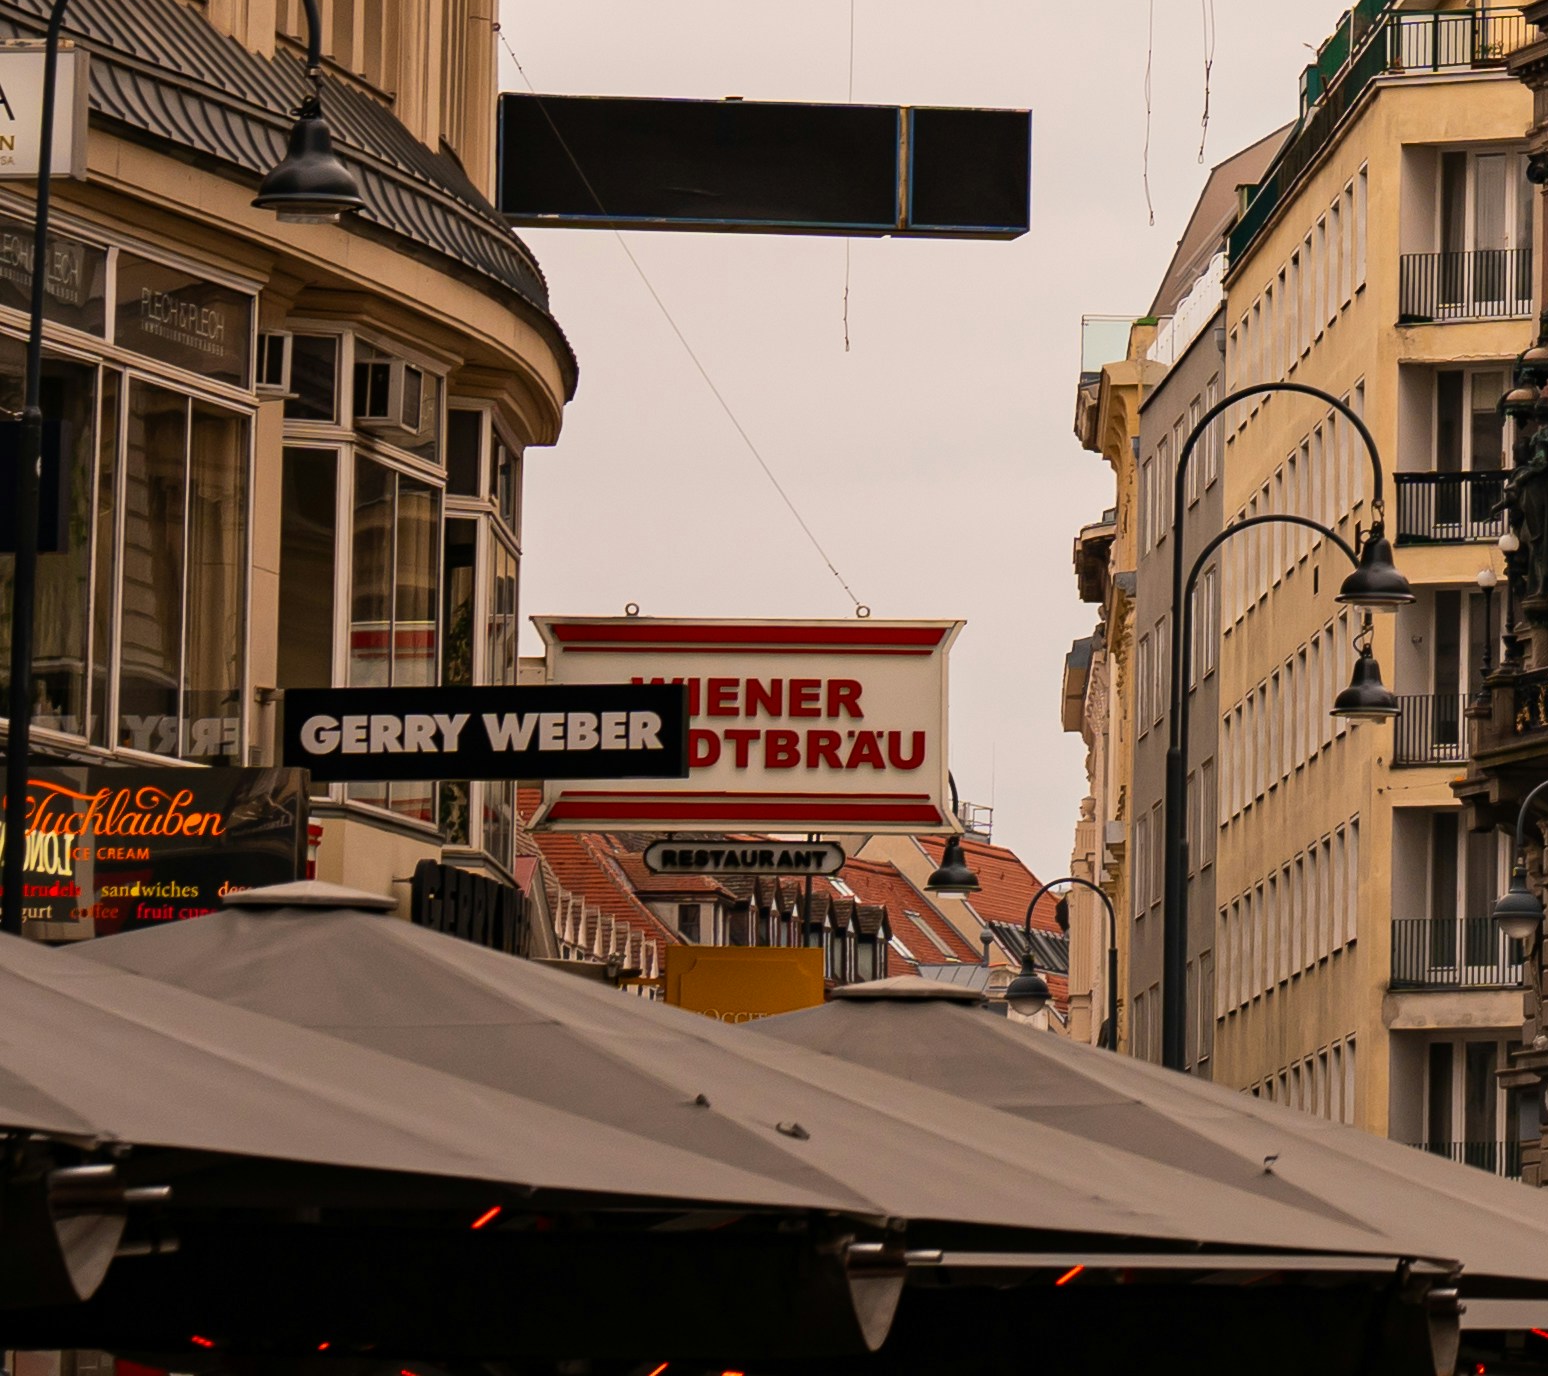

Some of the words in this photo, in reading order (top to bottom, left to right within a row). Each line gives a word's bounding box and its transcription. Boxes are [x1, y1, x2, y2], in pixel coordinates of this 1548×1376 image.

[631, 676, 864, 719] IENER
[301, 713, 471, 754] GERRY
[482, 710, 664, 752] WEBER
[688, 729, 926, 771] DTBRÄU
[97, 847, 150, 860] CREAM
[661, 849, 828, 869] RESTAURANT
[22, 880, 82, 897] trudels
[101, 881, 200, 898] sandwiches
[136, 902, 174, 921] fruit
